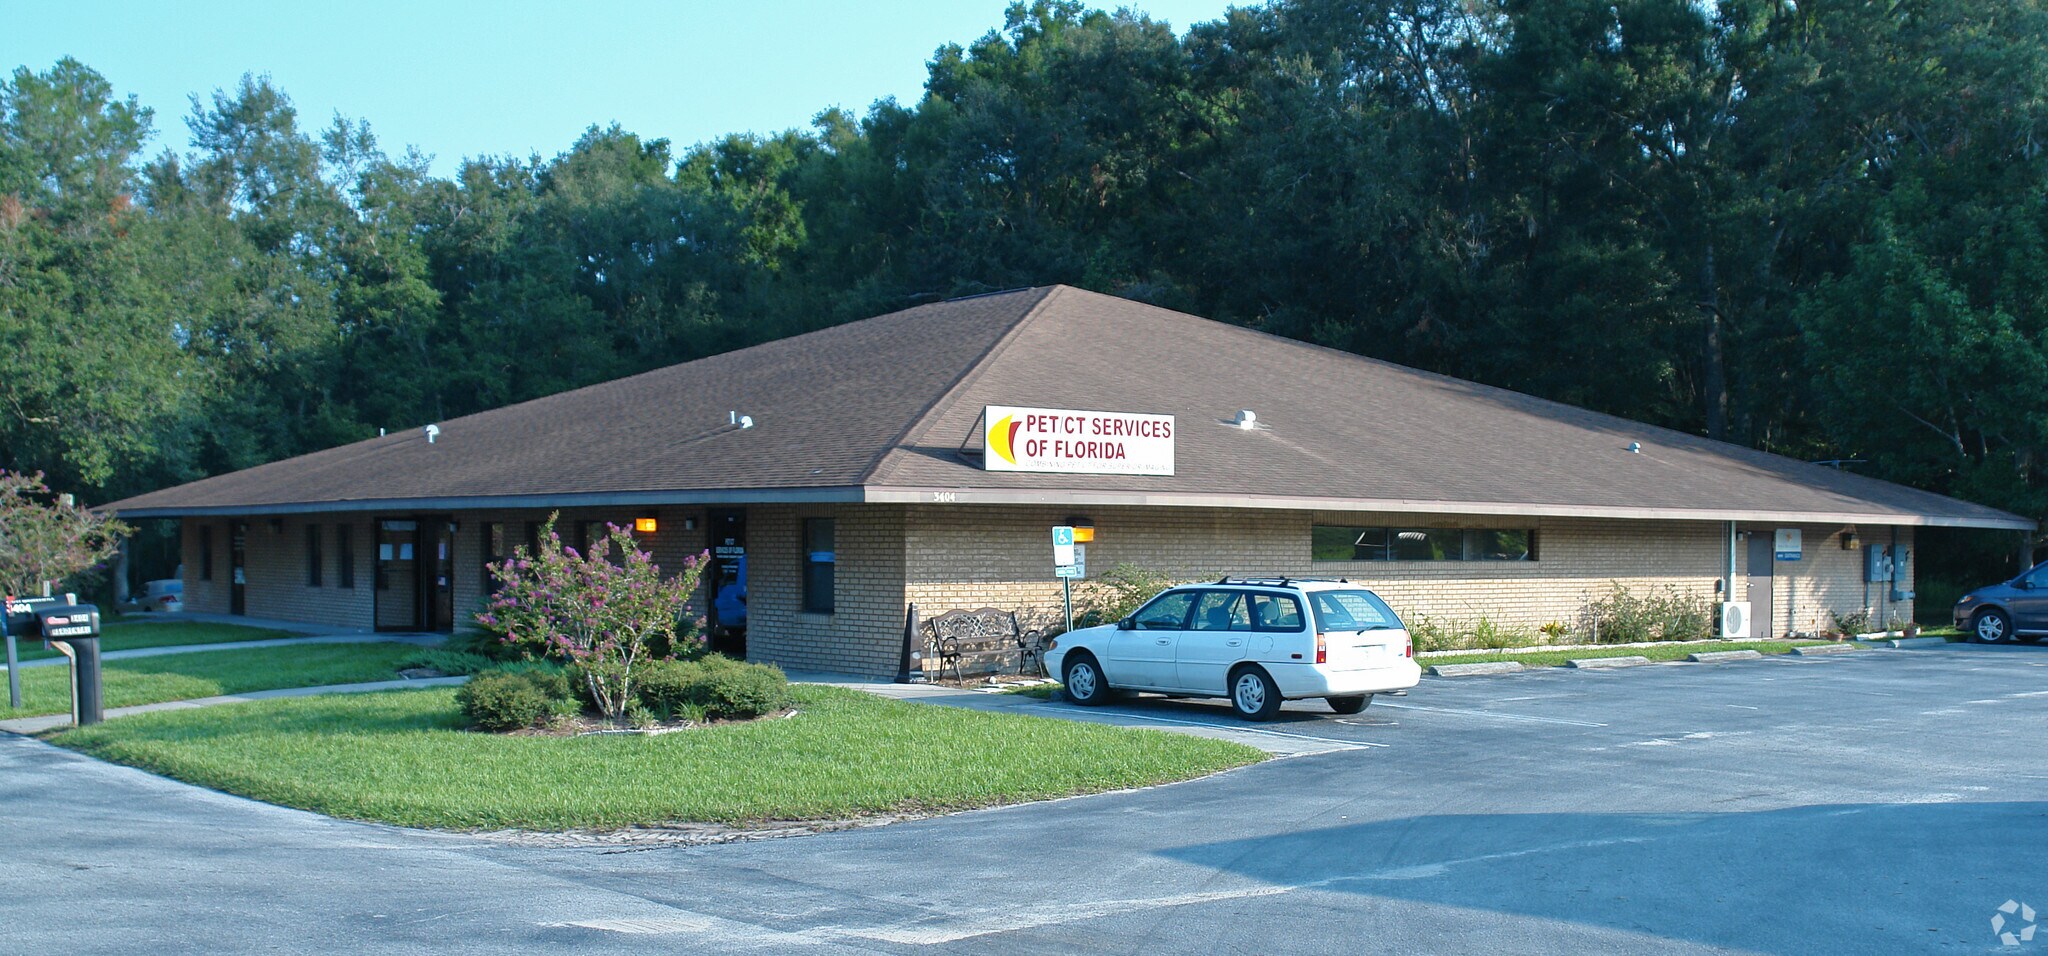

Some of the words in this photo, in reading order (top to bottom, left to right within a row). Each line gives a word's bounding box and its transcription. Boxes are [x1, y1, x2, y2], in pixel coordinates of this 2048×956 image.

[1027, 414, 1086, 434] PET/CT
[1092, 417, 1171, 438] SERVICES
[1026, 438, 1048, 457] OF
[1055, 440, 1126, 459] FLORIDA
